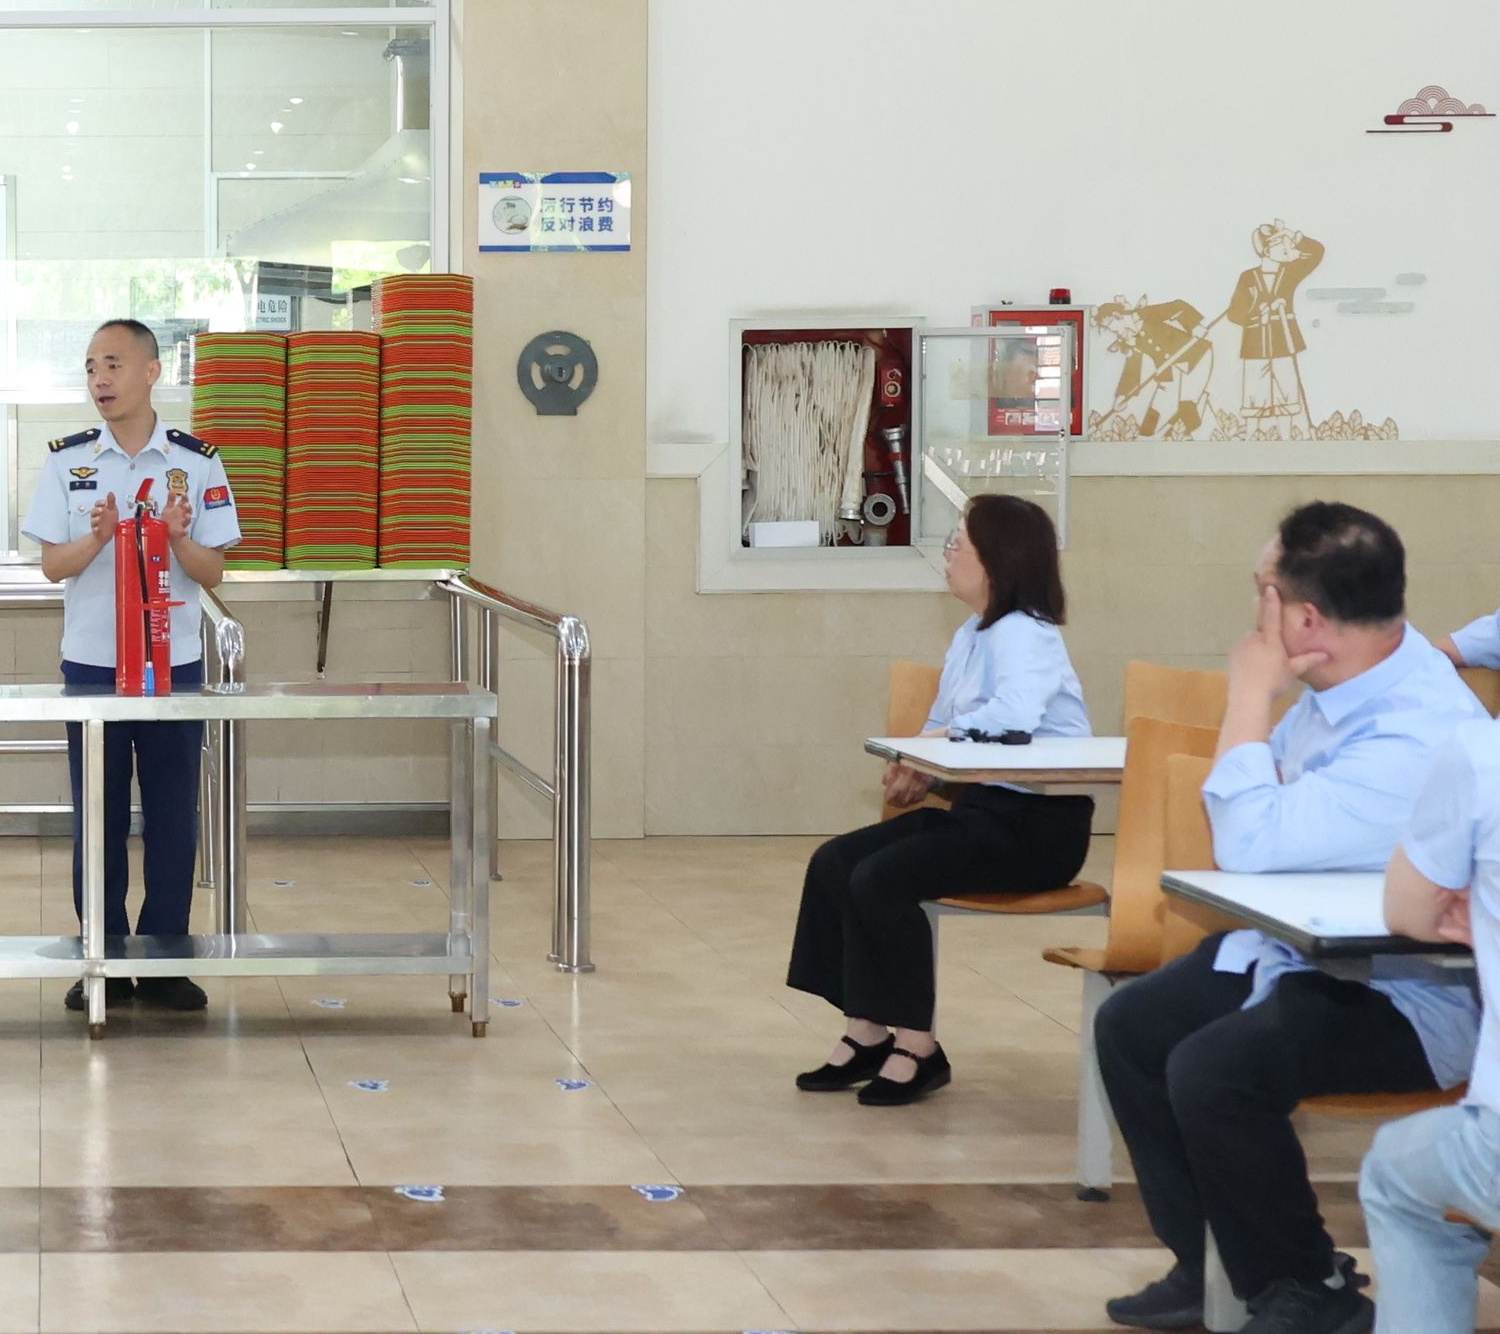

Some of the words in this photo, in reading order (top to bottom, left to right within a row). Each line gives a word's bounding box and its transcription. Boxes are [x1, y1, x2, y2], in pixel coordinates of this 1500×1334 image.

[539, 197, 615, 213] 厉行节约
[540, 216, 615, 233] 反对浪费
